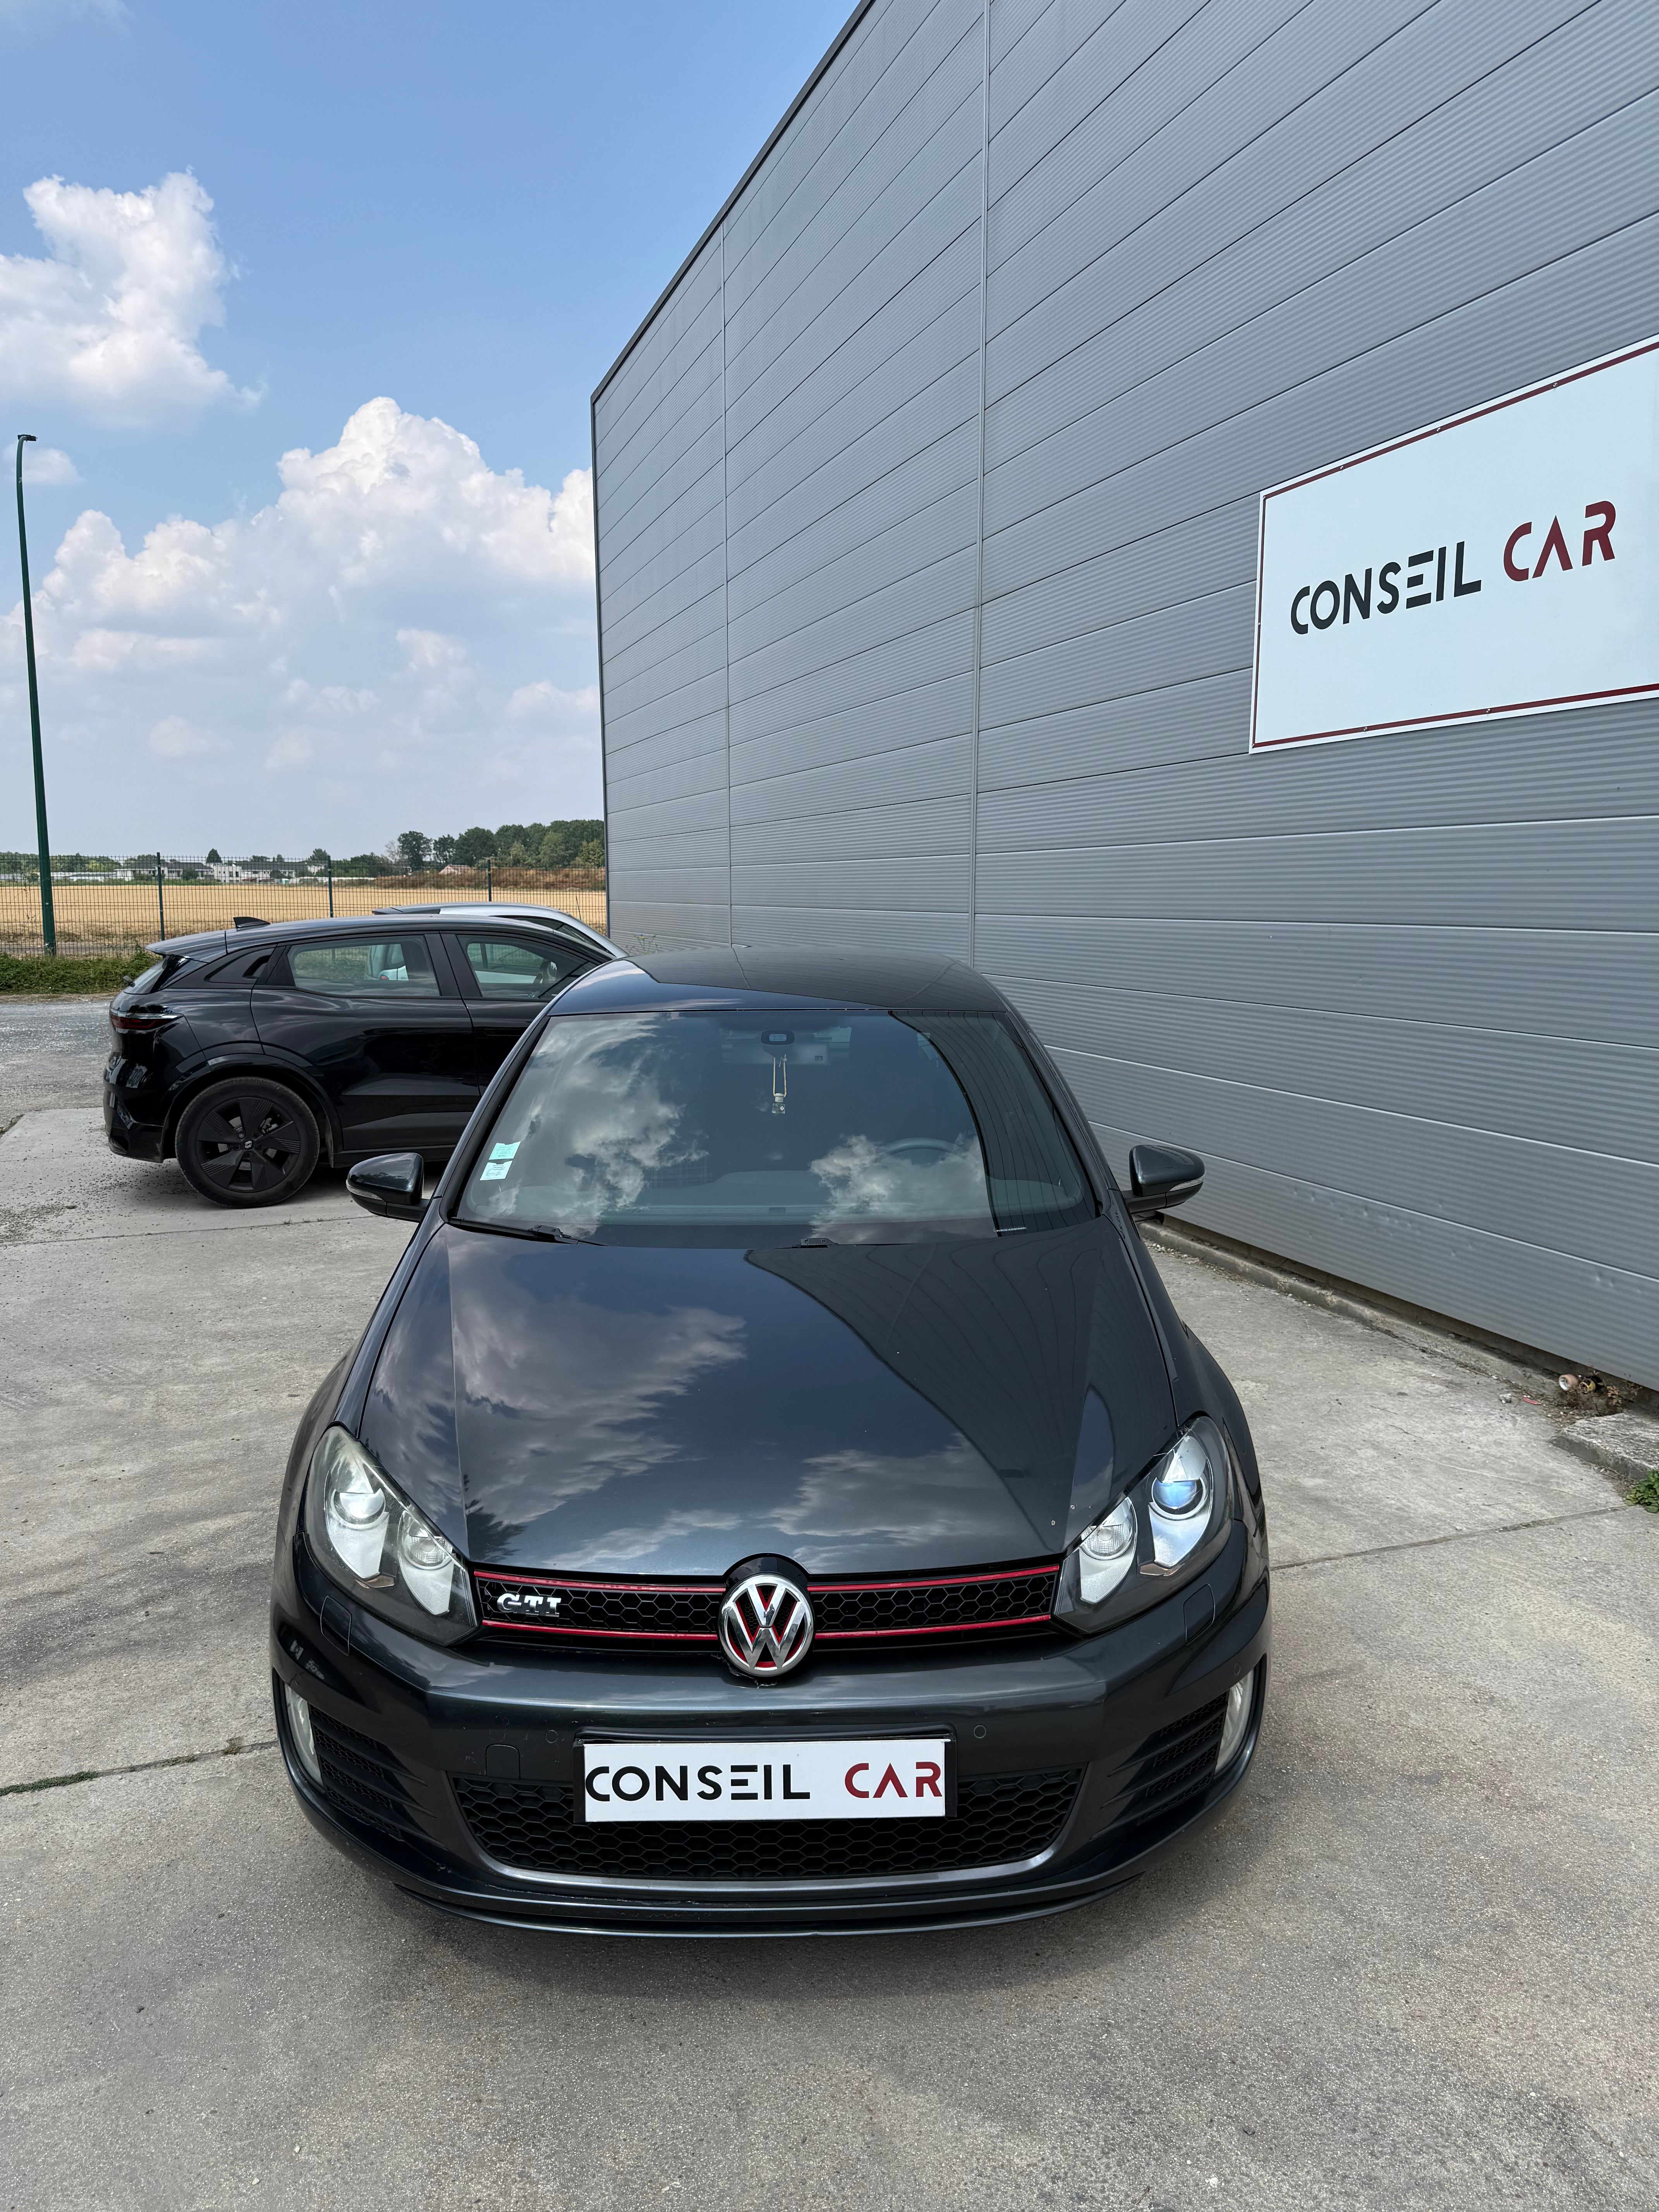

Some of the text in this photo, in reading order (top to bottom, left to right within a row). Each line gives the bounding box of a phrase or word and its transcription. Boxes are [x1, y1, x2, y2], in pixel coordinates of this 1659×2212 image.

[1291, 501, 1616, 635] CONSEIL CAR
[497, 1593, 562, 1617] GTI
[586, 1762, 943, 1802] CONSEIL CAR
